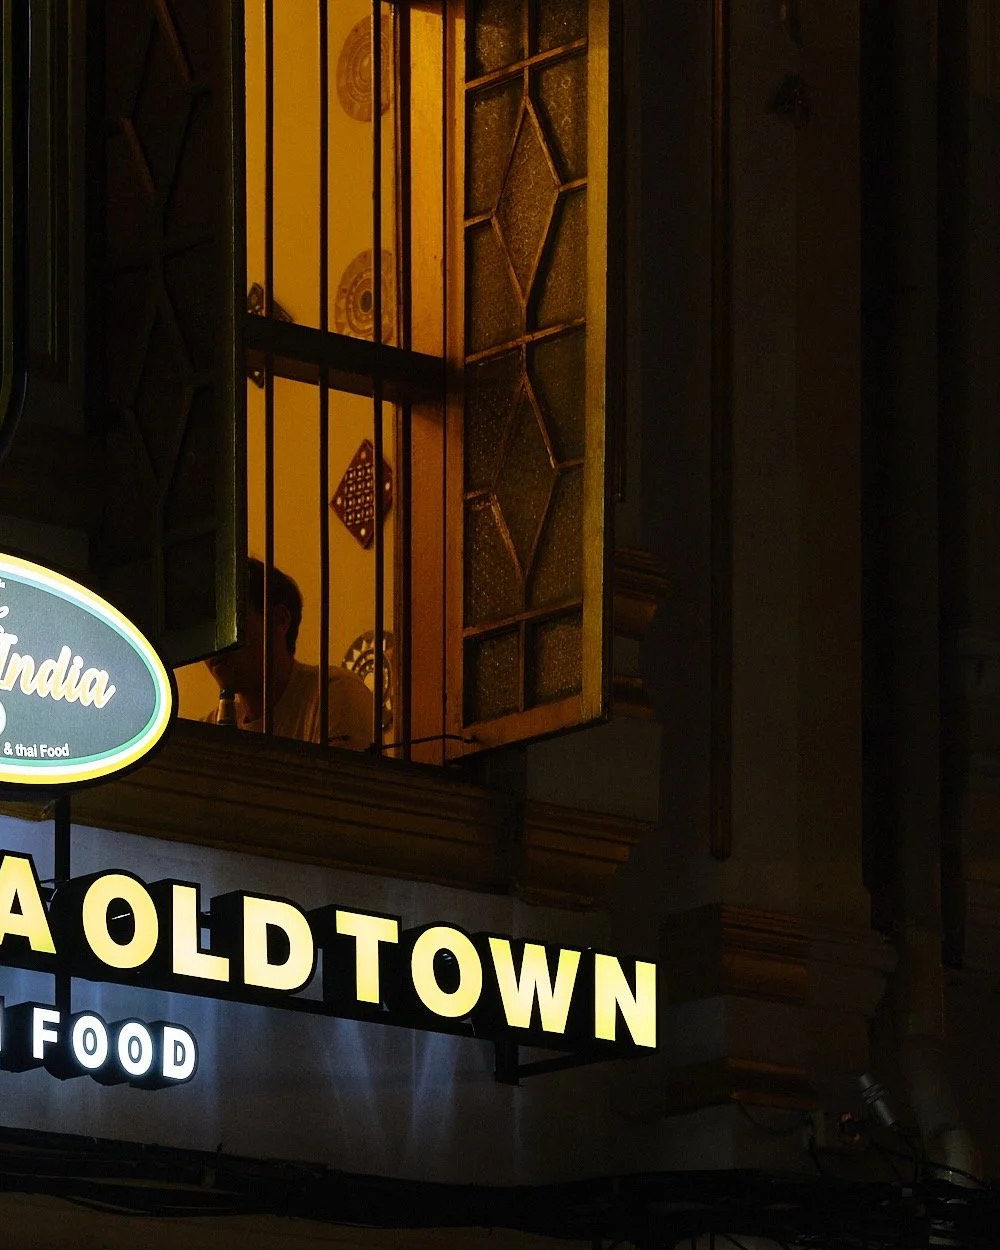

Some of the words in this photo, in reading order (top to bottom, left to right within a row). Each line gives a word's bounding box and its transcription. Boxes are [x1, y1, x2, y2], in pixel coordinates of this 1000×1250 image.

[3, 741, 14, 756] &
[14, 743, 38, 758] thai
[39, 743, 70, 758] Food
[81, 873, 315, 992] OLD
[335, 909, 657, 1049] TOWN
[32, 1006, 198, 1082] FOOD
